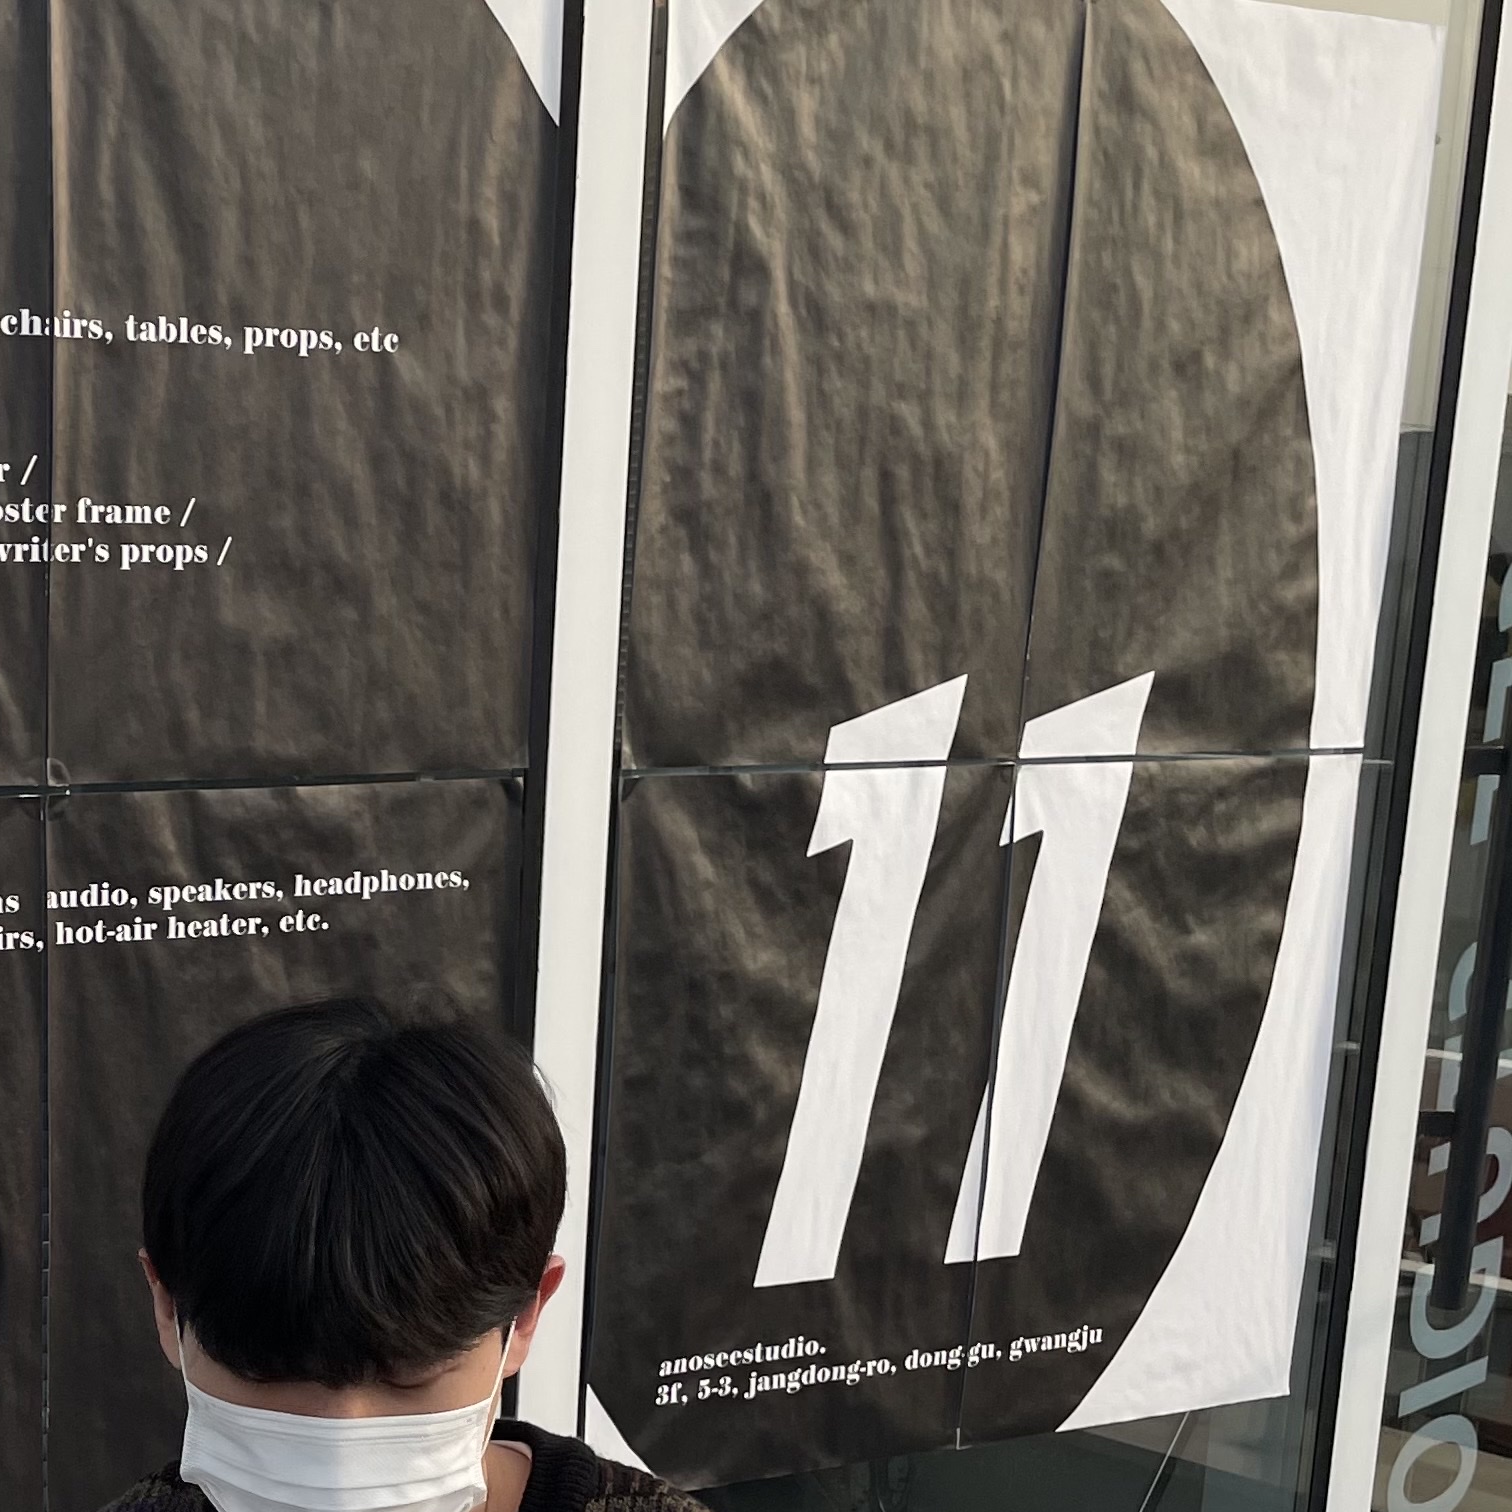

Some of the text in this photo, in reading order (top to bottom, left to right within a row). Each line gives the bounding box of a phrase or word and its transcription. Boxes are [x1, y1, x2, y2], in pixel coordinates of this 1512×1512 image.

[0, 309, 113, 345] chairs,
[124, 315, 233, 349] tables,
[243, 327, 343, 357] props,
[353, 327, 399, 353] etc
[76, 498, 171, 524] frame
[119, 545, 209, 571] props
[47, 882, 138, 909] audio,
[148, 879, 284, 911] speakers,
[294, 869, 470, 900] headphones,
[55, 917, 158, 945] hot-air
[166, 914, 269, 939] heater,
[279, 910, 329, 933] etc.
[753, 670, 1155, 1288] 11
[655, 1382, 688, 1405] 3f,
[697, 1377, 739, 1400] 5-3,
[743, 1359, 897, 1399] jangdong-ro,
[1009, 1325, 1103, 1362] gwangju
[658, 1336, 826, 1377] anoseestudio.
